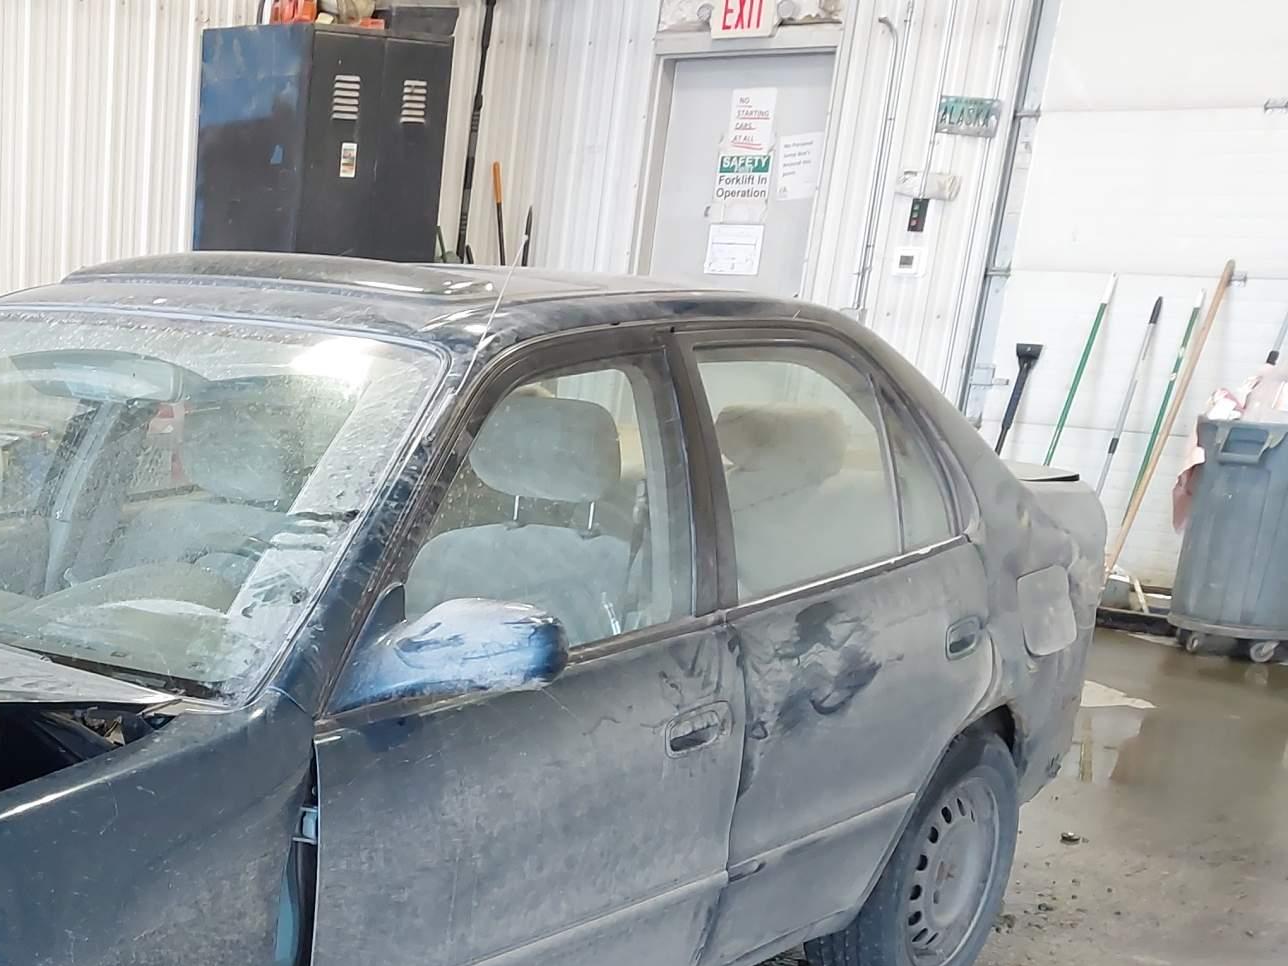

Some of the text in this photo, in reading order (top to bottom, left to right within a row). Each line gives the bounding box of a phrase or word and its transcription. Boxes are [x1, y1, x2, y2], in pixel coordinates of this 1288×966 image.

[722, 0, 763, 30] EXIT
[738, 97, 750, 105] NO
[737, 110, 770, 118] STARTING
[939, 105, 990, 128] ALASKA
[722, 155, 769, 168] SAFETY
[718, 174, 767, 185] Forklift In
[716, 187, 766, 200] Operation
